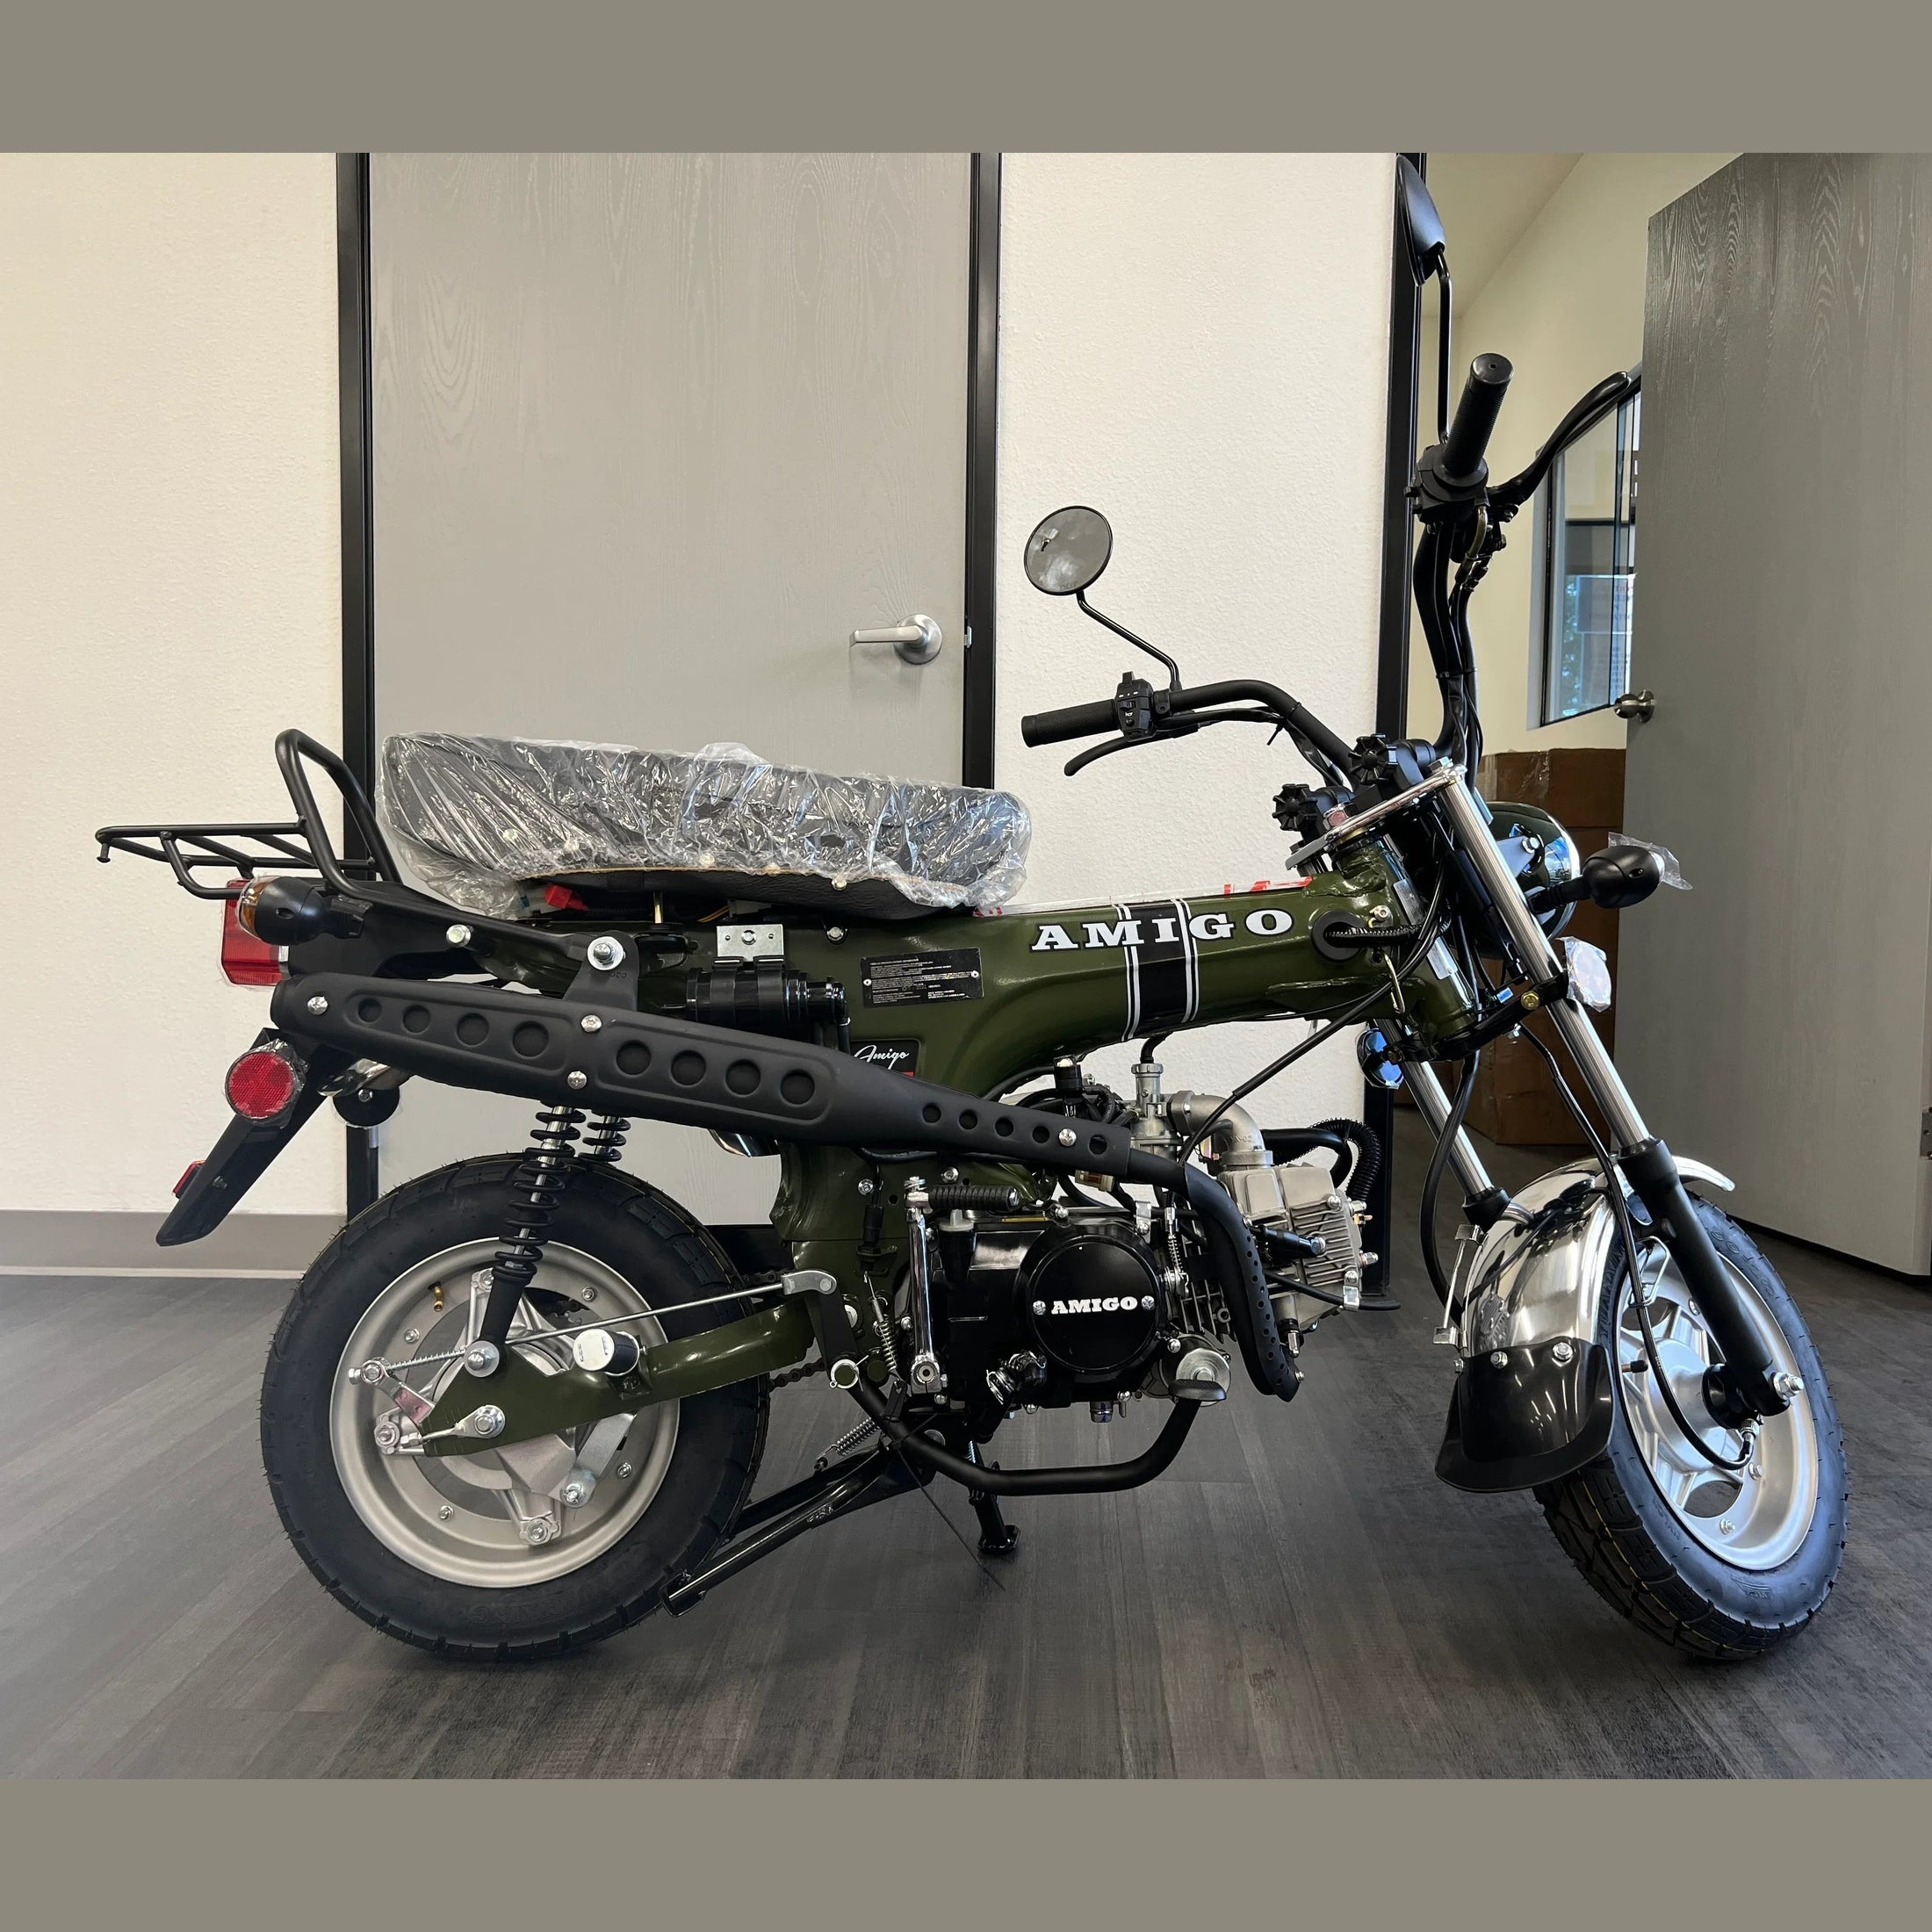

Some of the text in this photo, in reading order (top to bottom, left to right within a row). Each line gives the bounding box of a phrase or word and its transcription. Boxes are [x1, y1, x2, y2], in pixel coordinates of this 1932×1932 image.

[1031, 909, 1293, 950] AMIGO
[854, 1044, 910, 1071] Amigo
[1051, 1296, 1138, 1315] AMIGO
